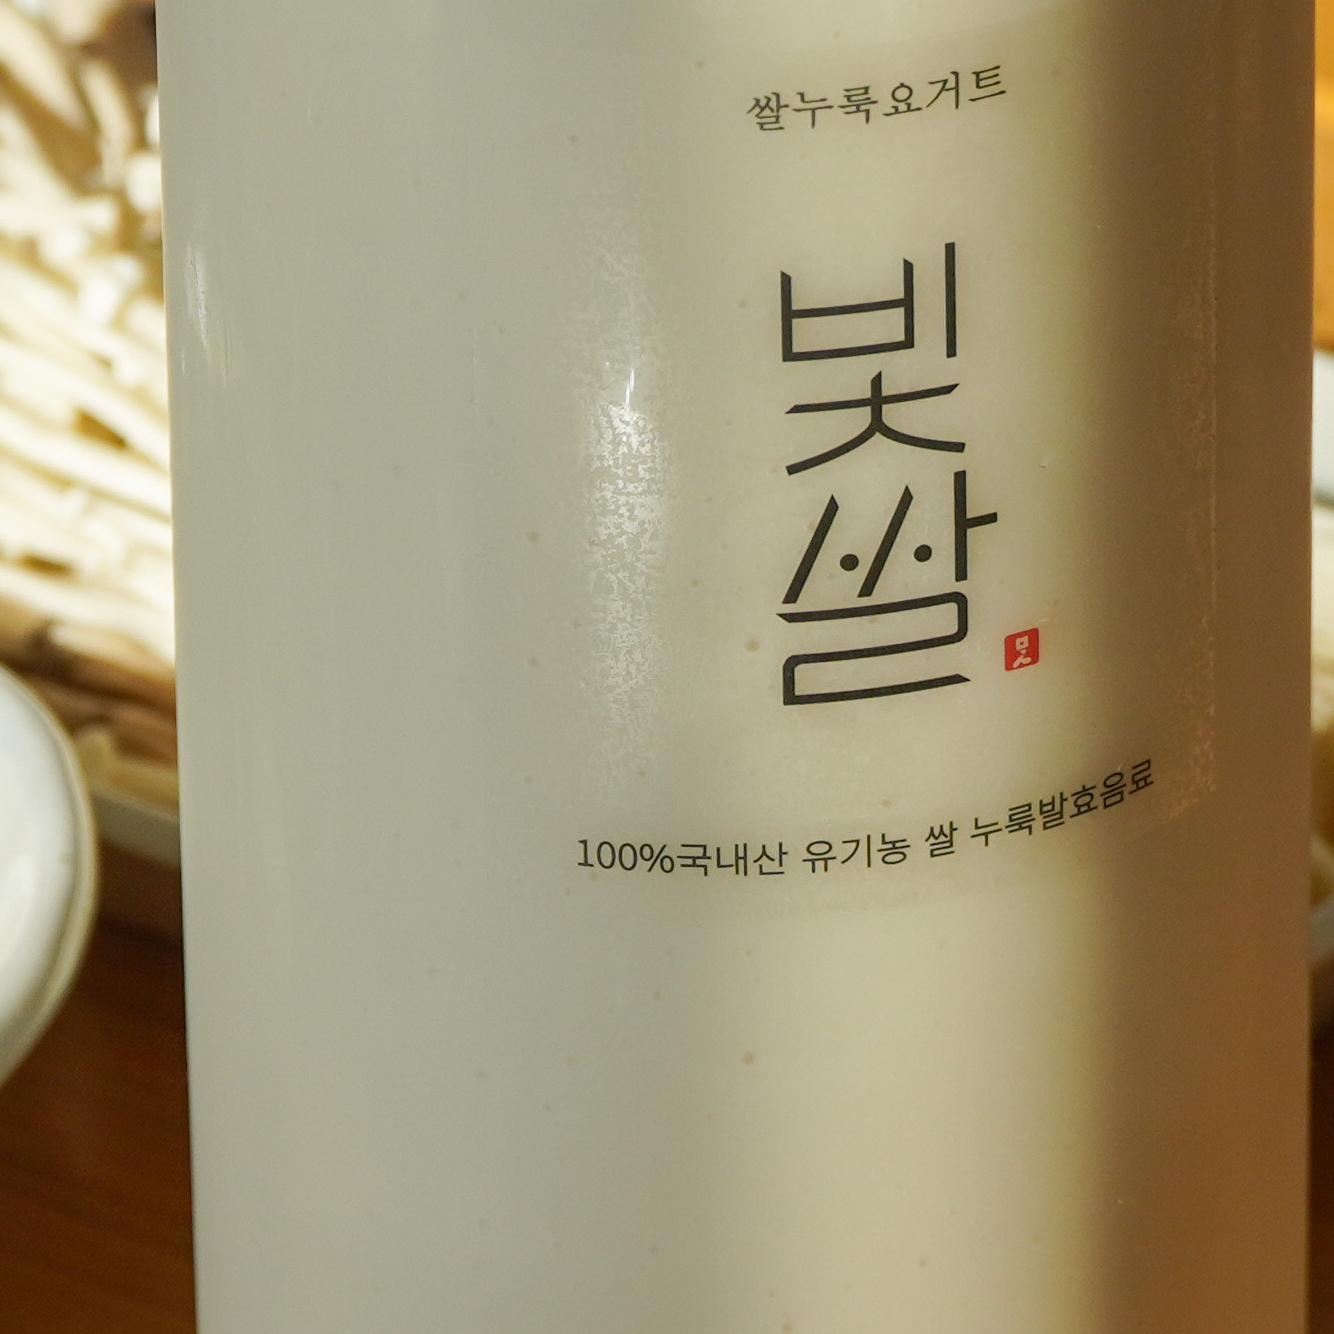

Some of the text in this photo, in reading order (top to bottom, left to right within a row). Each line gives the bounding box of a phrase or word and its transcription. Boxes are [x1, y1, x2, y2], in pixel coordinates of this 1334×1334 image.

[746, 64, 1007, 132] 쌀누룩요거트
[576, 758, 1155, 878] 100%국내산 유기농 쌀 누룩발효음료
